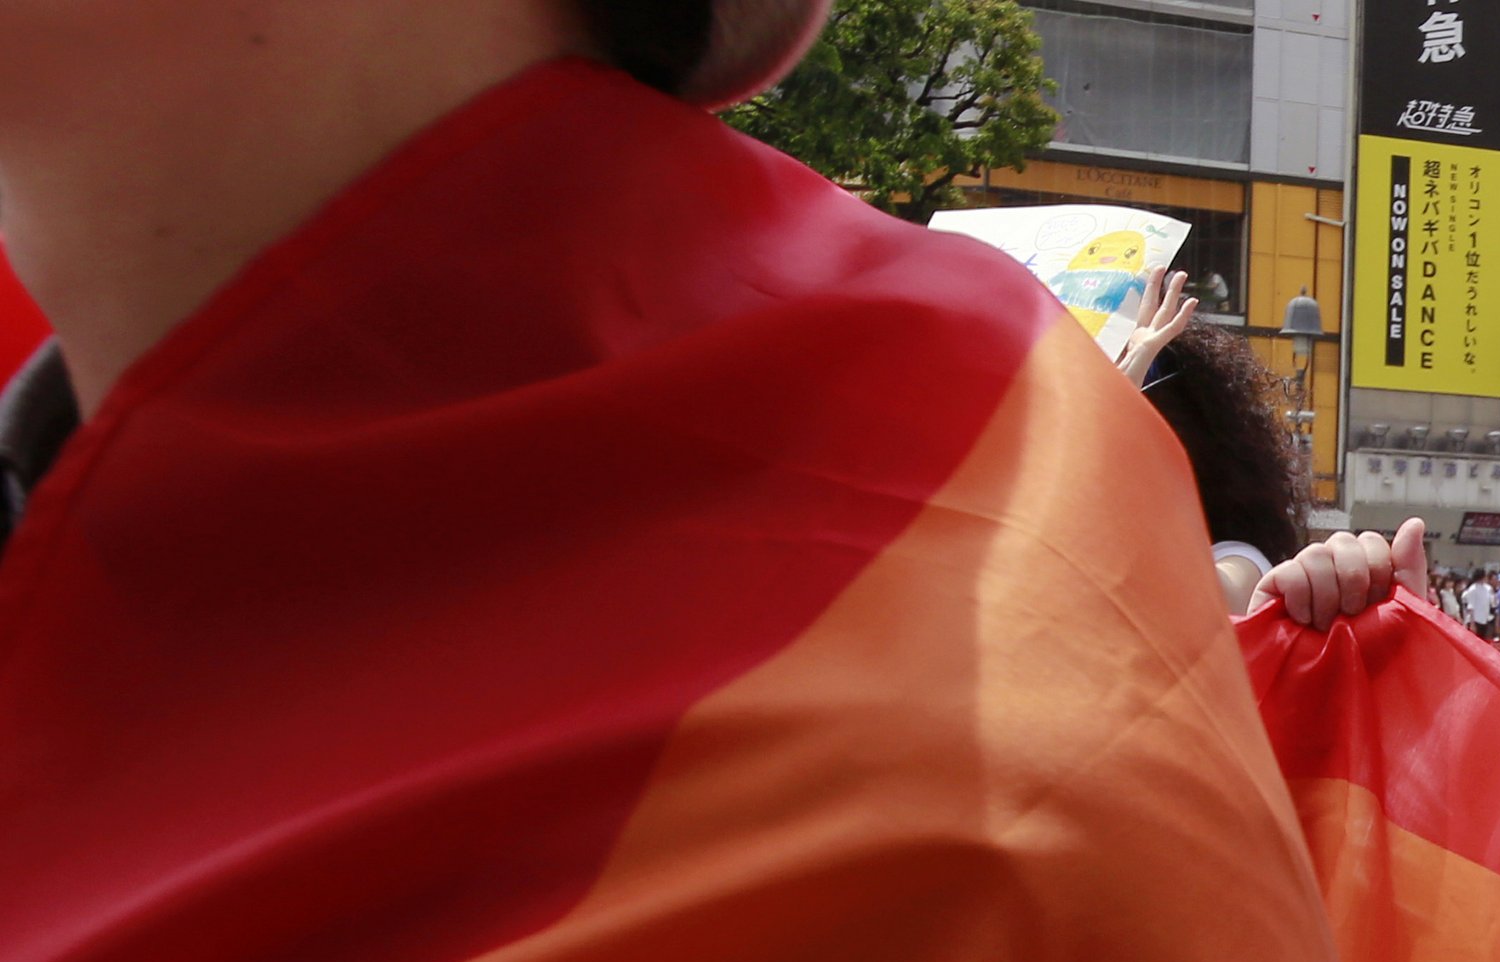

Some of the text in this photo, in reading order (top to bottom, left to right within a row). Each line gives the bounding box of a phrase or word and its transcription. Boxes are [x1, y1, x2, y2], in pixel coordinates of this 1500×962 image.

[1418, 0, 1466, 63] 急
[1448, 163, 1458, 252] NEW SINGLE
[1390, 184, 1408, 339] NOW ON SALE
